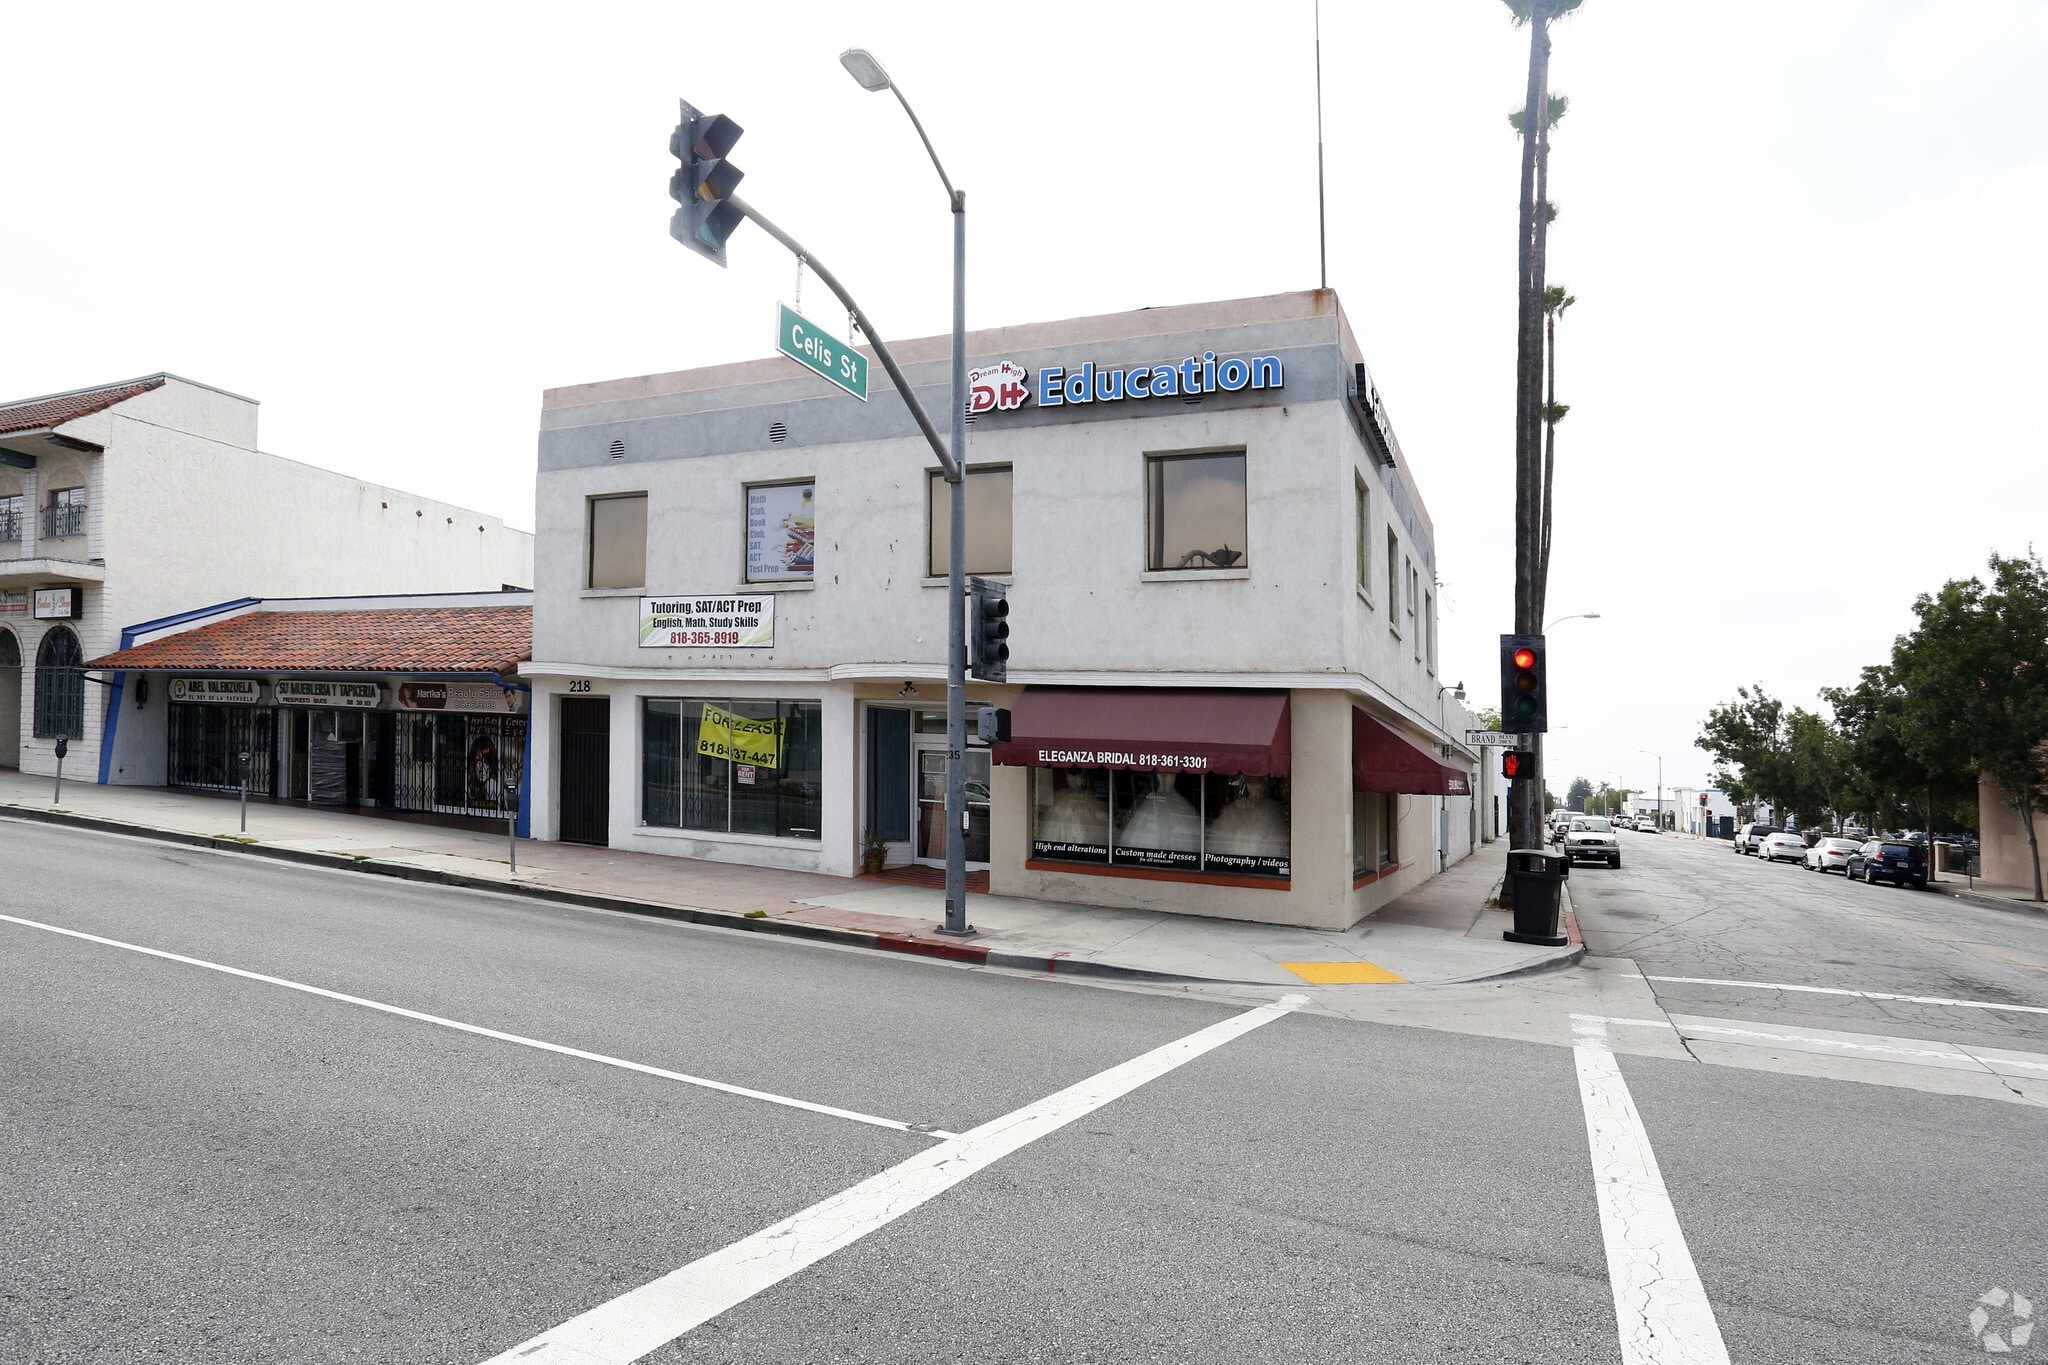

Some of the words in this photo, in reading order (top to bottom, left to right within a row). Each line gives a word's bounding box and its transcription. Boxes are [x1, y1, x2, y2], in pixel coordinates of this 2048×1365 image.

[792, 324, 832, 367] Celis
[840, 354, 858, 383] St
[969, 365, 999, 382] Dream
[1001, 363, 1023, 378] High
[1038, 351, 1284, 406] Education
[971, 383, 1026, 410] DH
[750, 495, 766, 504] Math
[750, 518, 766, 527] Book
[749, 553, 761, 562] ACT
[749, 565, 763, 574] Test
[764, 564, 779, 574] Prep
[651, 601, 694, 615] Tutoring,
[695, 600, 735, 613] SAT/ACT
[737, 599, 762, 614] Prep
[652, 617, 684, 630] English,
[685, 617, 708, 629] Math,
[708, 617, 733, 630] Study
[734, 616, 759, 628] Skills
[670, 631, 739, 645] 818-365-8919
[188, 681, 206, 693] ABEL
[208, 681, 253, 694] VALENZUELA
[279, 682, 289, 695] SU
[290, 683, 331, 697] MUEBLERIA
[331, 684, 338, 697] Y
[339, 684, 376, 699] TAPICERIA
[417, 689, 447, 699] Martha's
[448, 687, 477, 700] Beauty
[479, 688, 503, 700] Salon
[570, 680, 591, 693] 218
[705, 709, 731, 729] FOR
[734, 719, 783, 736] LEASE
[1471, 735, 1496, 743] BRAND
[1038, 750, 1095, 765] ELEGANZA
[1096, 752, 1137, 766] BRIDAL
[1139, 754, 1208, 769] 818-361-3301
[1035, 842, 1052, 852] High
[1053, 843, 1066, 851] end
[1067, 844, 1107, 855] alterations
[1115, 848, 1144, 859] Custom
[1146, 849, 1167, 860] made
[1168, 851, 1197, 863] dresses
[1204, 854, 1256, 869] Photography
[1262, 858, 1289, 869] videos
